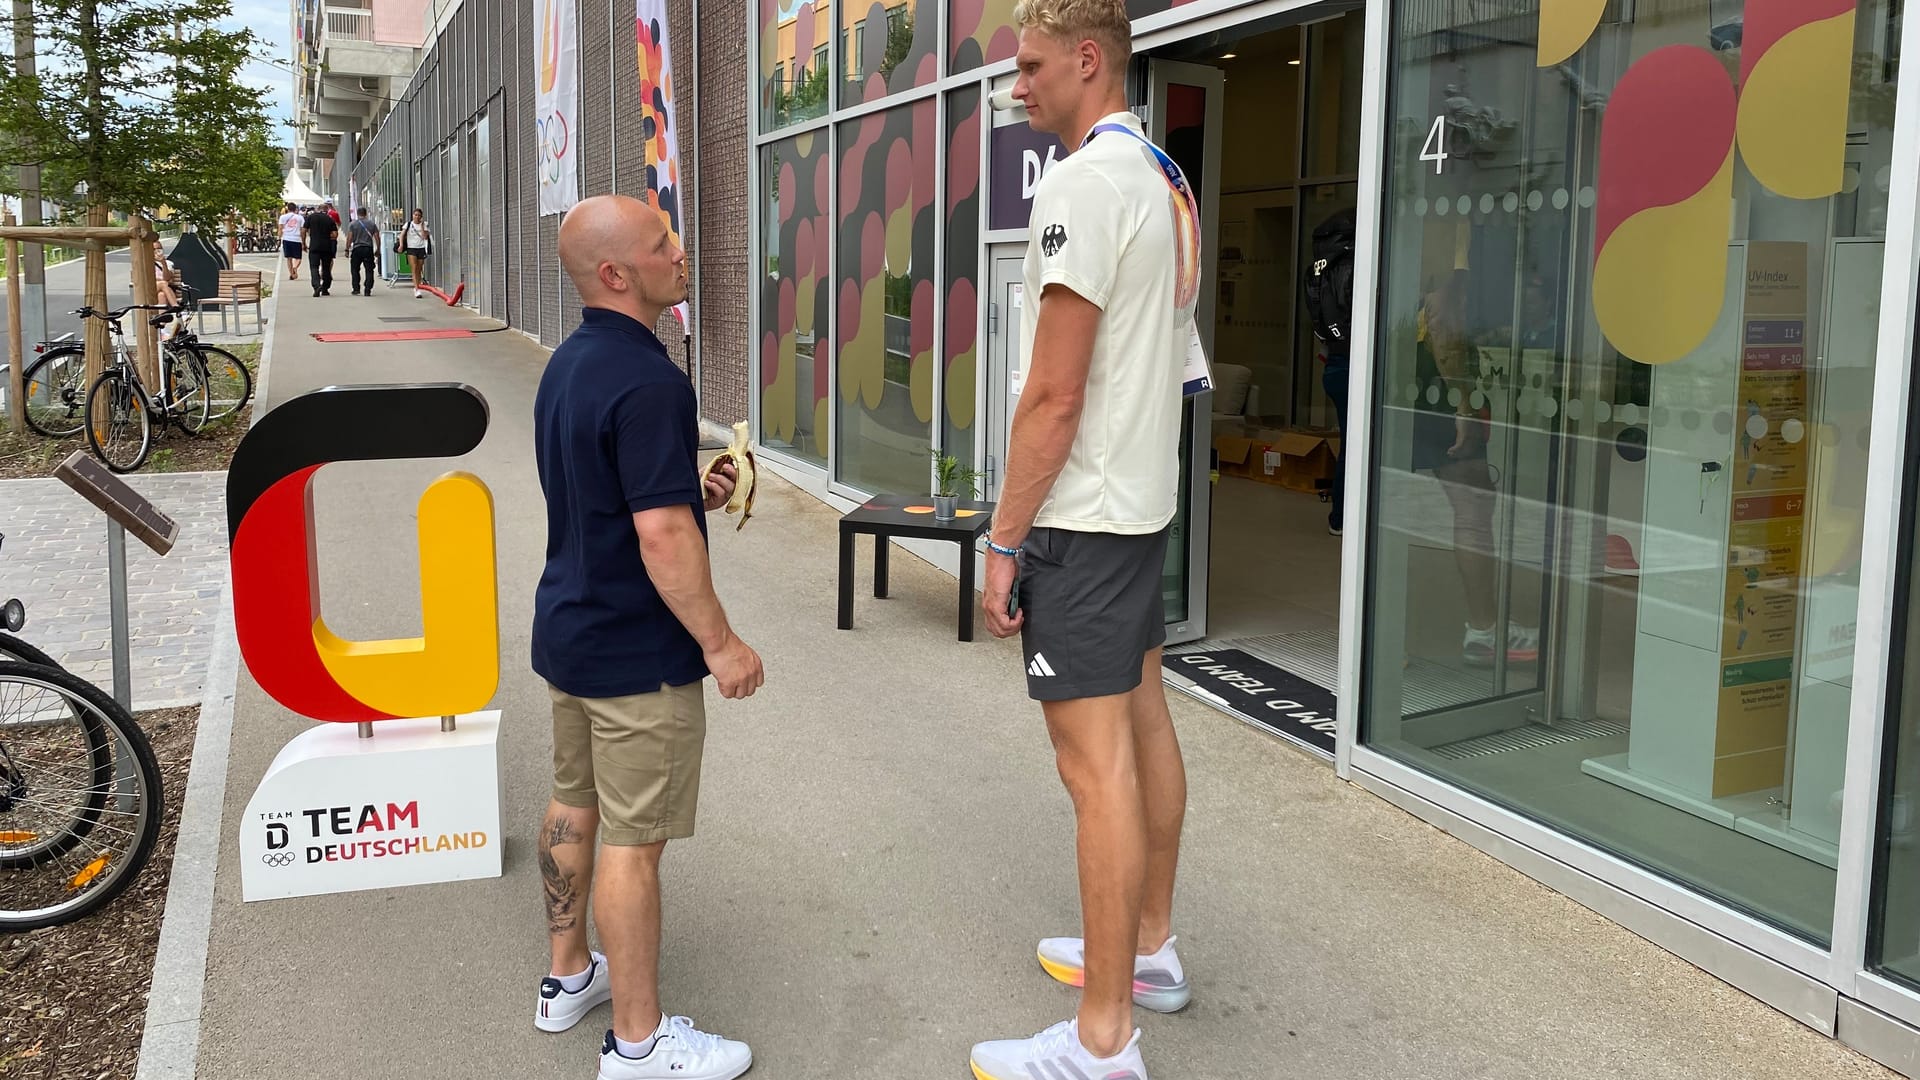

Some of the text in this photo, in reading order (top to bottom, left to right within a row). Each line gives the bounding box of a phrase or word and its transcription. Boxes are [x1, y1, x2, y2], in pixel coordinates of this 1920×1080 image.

[1419, 115, 1448, 174] 4
[1748, 271, 1789, 282] UV-Index
[1784, 328, 1801, 338] 11+
[1198, 664, 1277, 695] TEAM
[259, 811, 293, 820] TEAM
[303, 800, 419, 838] TEAM
[306, 831, 488, 864] DEUTSCHLAND
